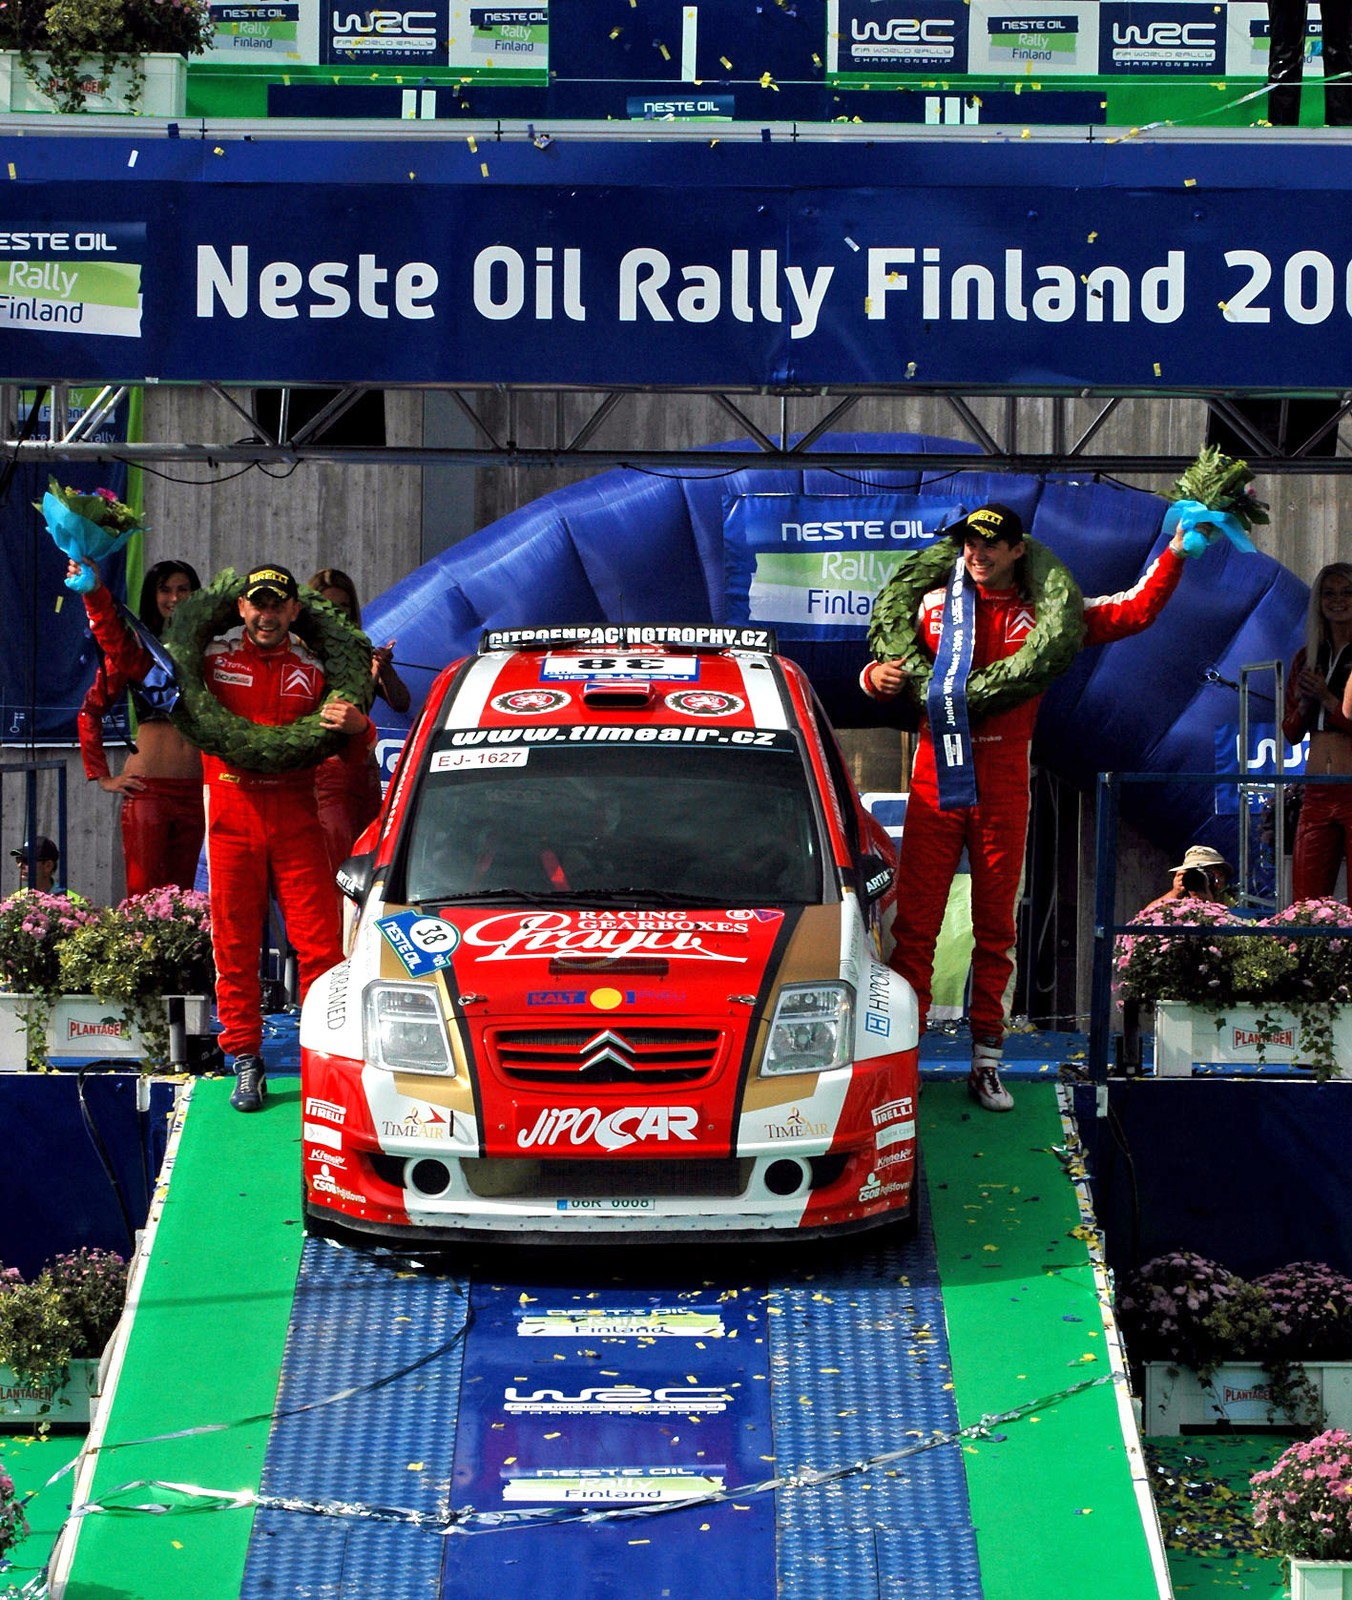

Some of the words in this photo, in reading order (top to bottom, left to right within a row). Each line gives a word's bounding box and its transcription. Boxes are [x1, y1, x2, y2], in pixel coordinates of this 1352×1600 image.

[222, 9, 266, 18] NESTE
[267, 9, 287, 18] OIL
[484, 12, 528, 21] NESTE
[529, 12, 548, 21] OIL
[239, 21, 270, 38] Rally
[333, 10, 437, 34] WRC
[851, 18, 955, 42] WRC
[1002, 20, 1045, 31] NESTE
[1047, 19, 1066, 30] OIL
[500, 24, 532, 41] Rally
[1112, 22, 1217, 46] WRC
[233, 36, 273, 49] Finland
[494, 40, 534, 52] Finland
[1018, 33, 1049, 49] Rally
[1012, 49, 1052, 60] Finland
[644, 102, 695, 112] NESTE
[697, 101, 719, 112] OIL
[0, 233, 70, 251] ESTE
[75, 233, 118, 251] OIL
[8, 261, 79, 298] Rally
[196, 244, 439, 319] Neste
[473, 246, 586, 322] Oil
[619, 248, 834, 339] Rally
[868, 247, 1185, 323] Finland
[1222, 249, 1352, 325] 20
[781, 521, 884, 542] NESTE
[890, 520, 934, 540] OIL
[821, 551, 895, 587] Rally
[807, 588, 874, 616] Finla
[577, 658, 667, 670] 38
[944, 695, 956, 726] Junior
[451, 725, 777, 747] www.timeair.cz
[478, 752, 521, 765] 1627
[578, 911, 687, 921] RACING
[577, 921, 749, 933] GEARBOXES
[416, 925, 448, 946] 38
[382, 921, 415, 954] NESTE
[403, 951, 422, 970] OIL
[533, 992, 576, 1003] KALT
[305, 1097, 347, 1125] PIRELLI
[871, 1097, 913, 1127] PIRELLI
[575, 1325, 666, 1334] Finland
[0, 1385, 52, 1401] LANTAGEN
[504, 1387, 727, 1403] WRC
[1225, 1388, 1274, 1402] PLANTAGE
[537, 1469, 643, 1478] NESTE
[649, 1467, 694, 1475] OIL
[578, 1478, 654, 1489] Rally
[565, 1489, 662, 1499] Finland
